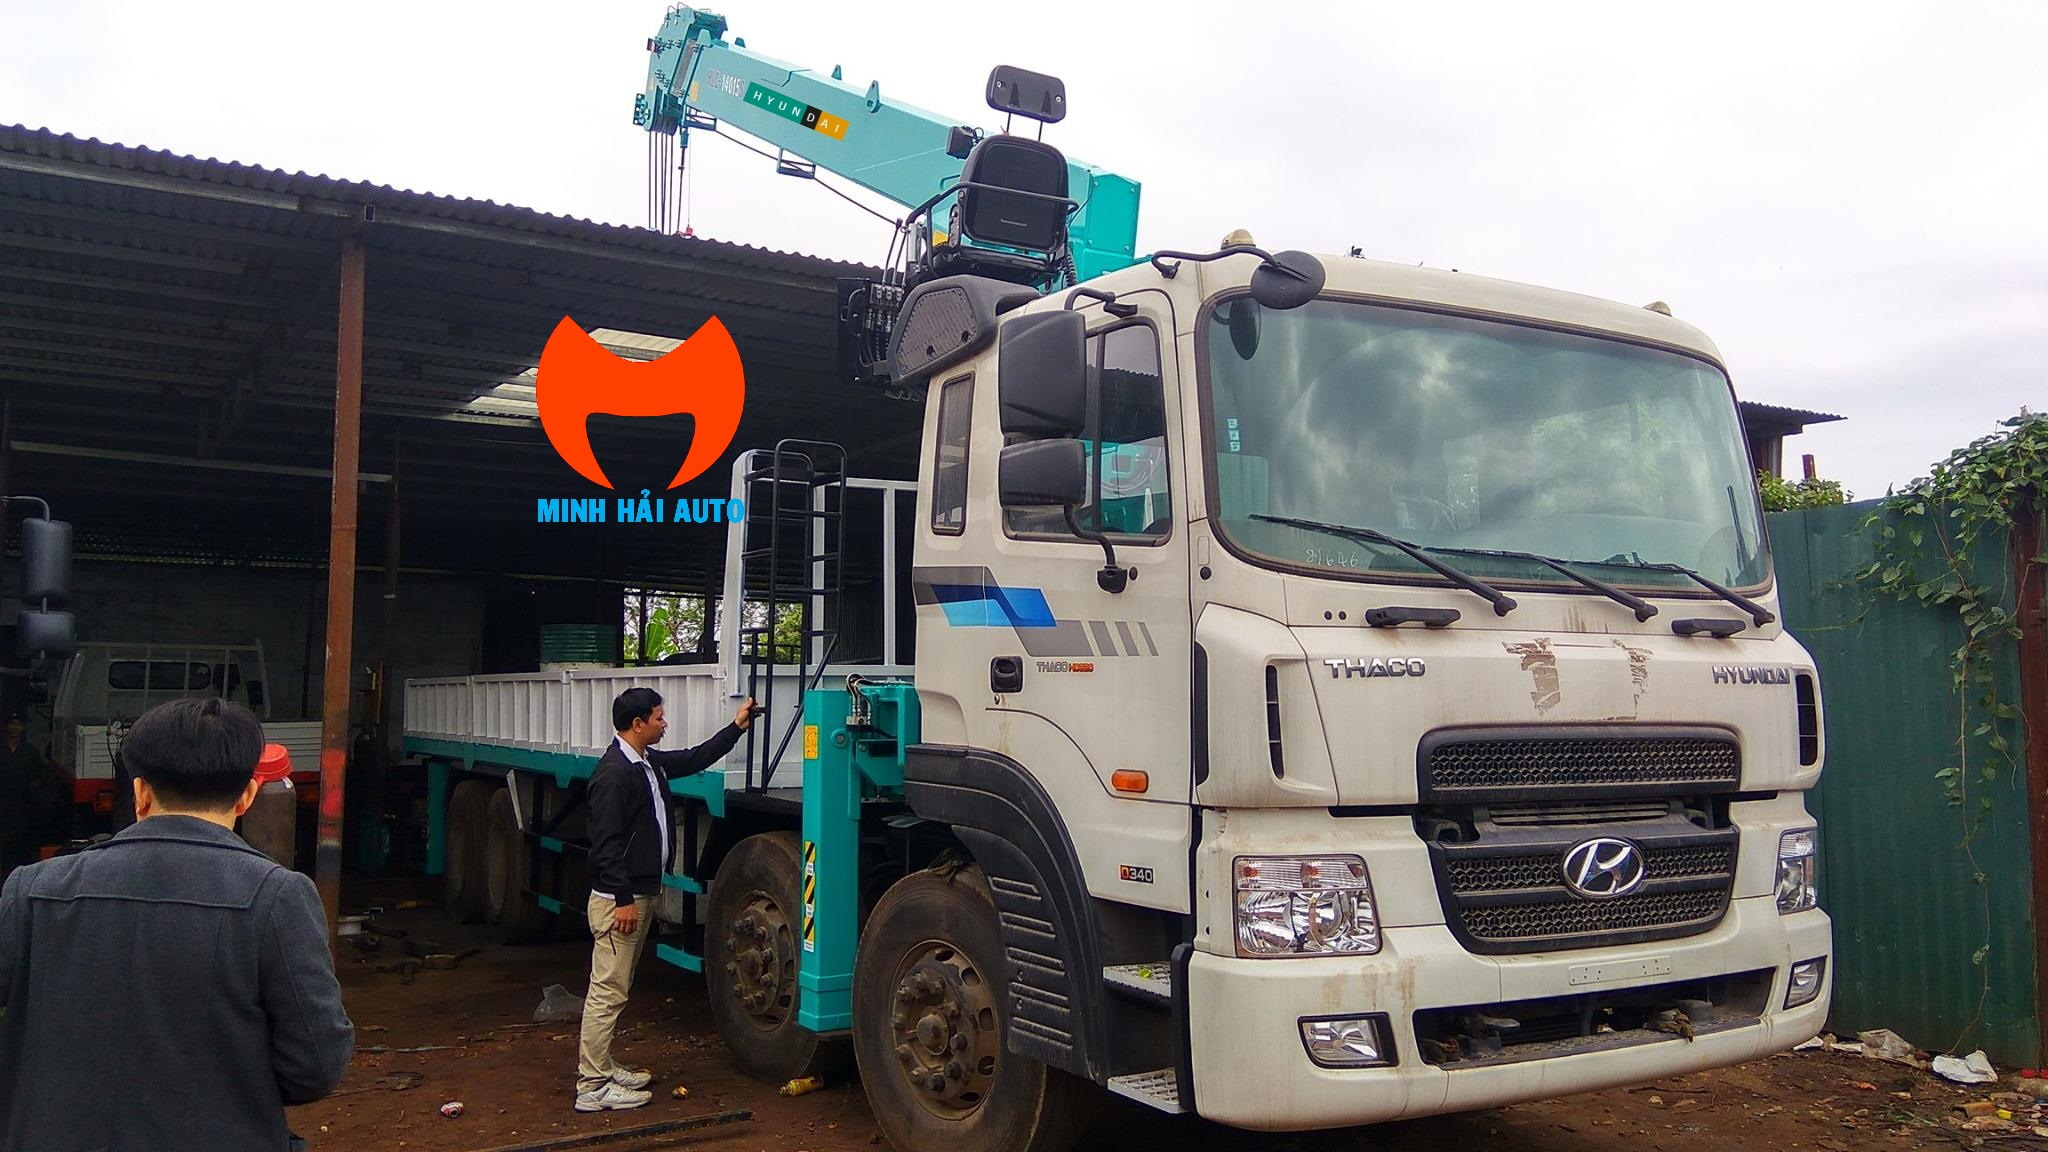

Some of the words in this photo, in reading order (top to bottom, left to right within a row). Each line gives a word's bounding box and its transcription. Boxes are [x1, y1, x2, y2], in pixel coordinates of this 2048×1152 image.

[753, 90, 839, 133] HYUNDAI
[1036, 661, 1068, 672] THACO
[1323, 658, 1425, 679] THACO
[1712, 665, 1790, 684] HYUNDAI
